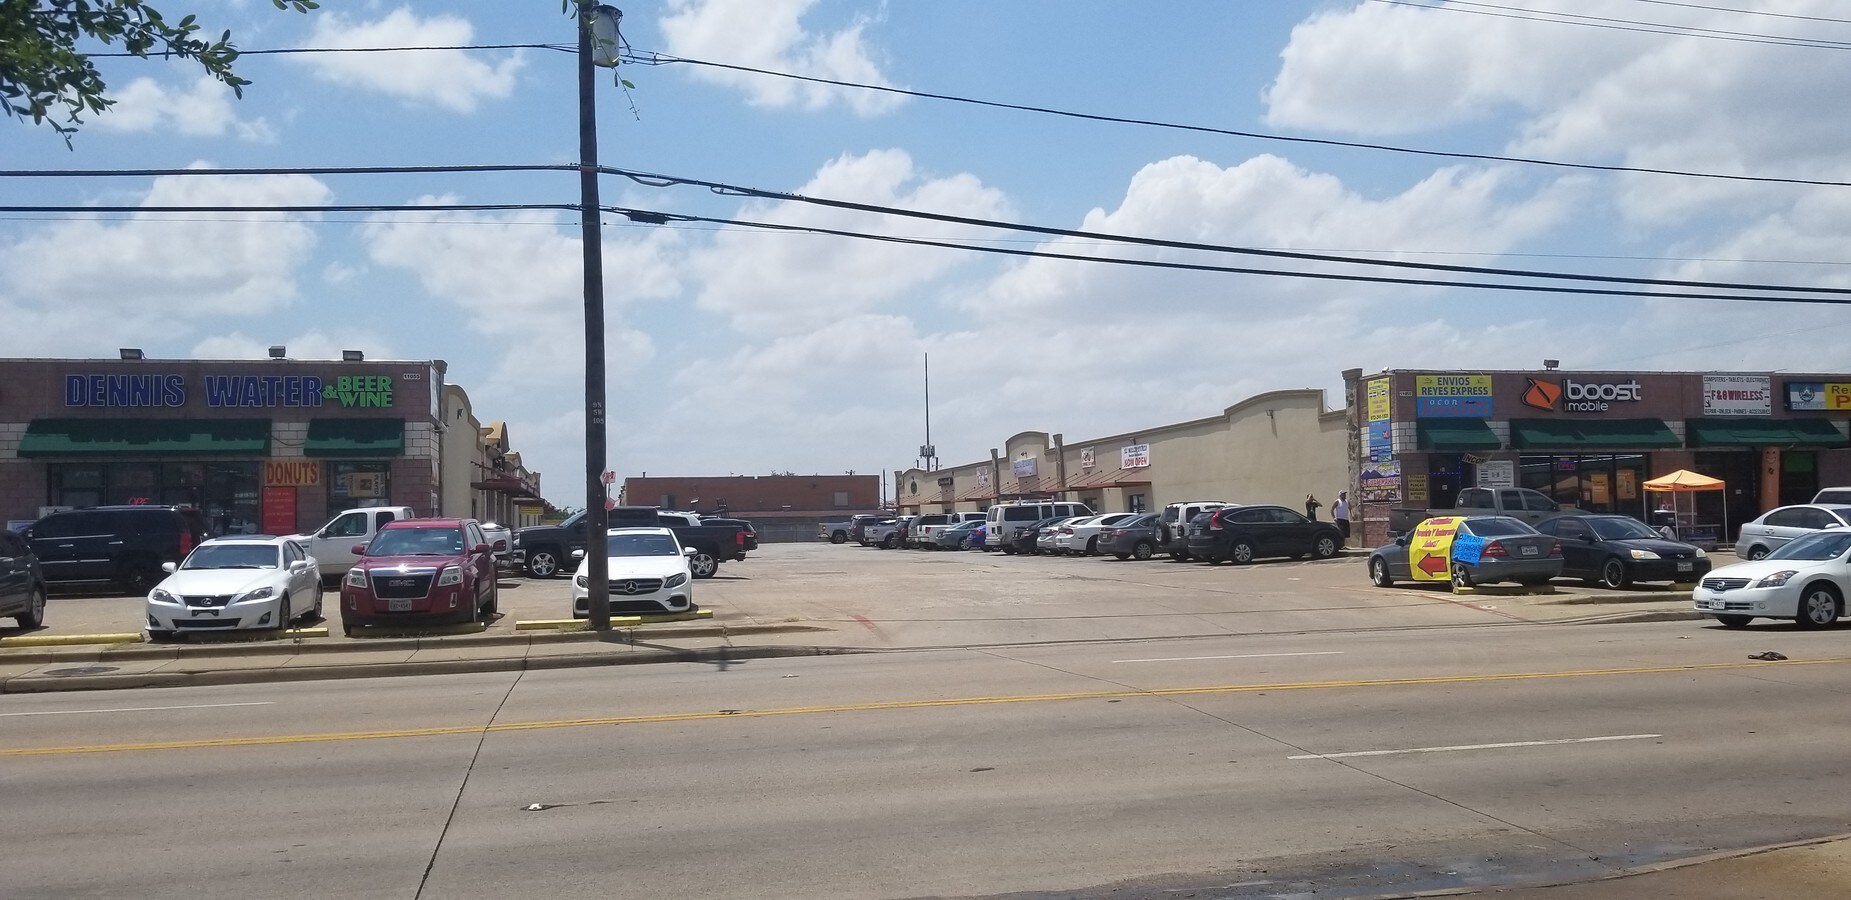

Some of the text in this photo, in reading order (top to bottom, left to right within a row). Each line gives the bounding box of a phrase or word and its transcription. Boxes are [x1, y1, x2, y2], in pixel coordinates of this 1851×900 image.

[338, 376, 392, 391] BEER
[1437, 376, 1470, 386] ENVIOS
[65, 374, 338, 407] DENNIS WATER &
[1421, 386, 1449, 396] REYES
[1450, 386, 1489, 396] EXPRESS
[1563, 379, 1642, 400] boost
[1728, 390, 1764, 401] WIRELESS
[338, 391, 392, 407] WINE
[1568, 401, 1609, 411] mobile
[1135, 456, 1148, 466] OPEN
[266, 462, 318, 484] DONUTS
